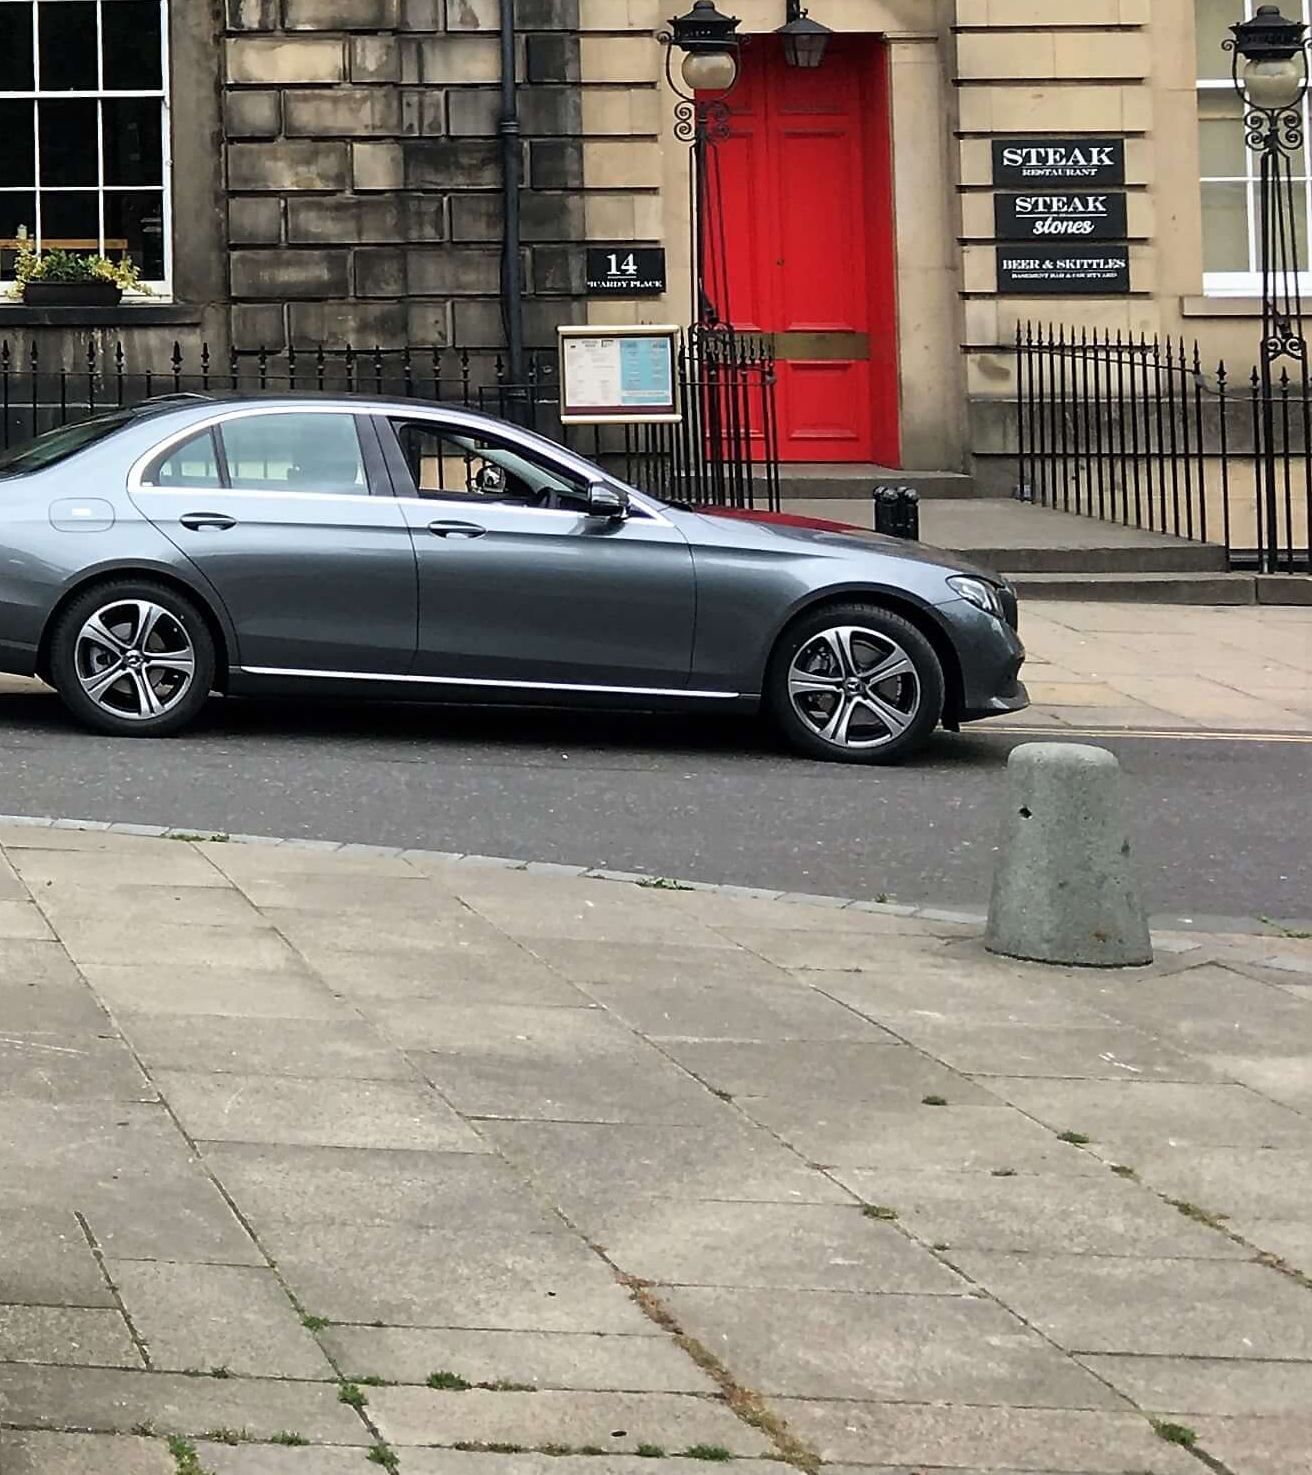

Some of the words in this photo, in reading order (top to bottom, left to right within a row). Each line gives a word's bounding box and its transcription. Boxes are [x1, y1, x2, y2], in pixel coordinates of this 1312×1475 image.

[1002, 147, 1114, 166] STEAK
[1022, 168, 1098, 176] RESTAURANT
[1015, 196, 1107, 212] STEAK
[1033, 216, 1094, 234] stones
[606, 253, 638, 274] 14
[1002, 259, 1039, 270] BEER
[1042, 259, 1053, 269] &
[1056, 258, 1126, 269] SKITTLES
